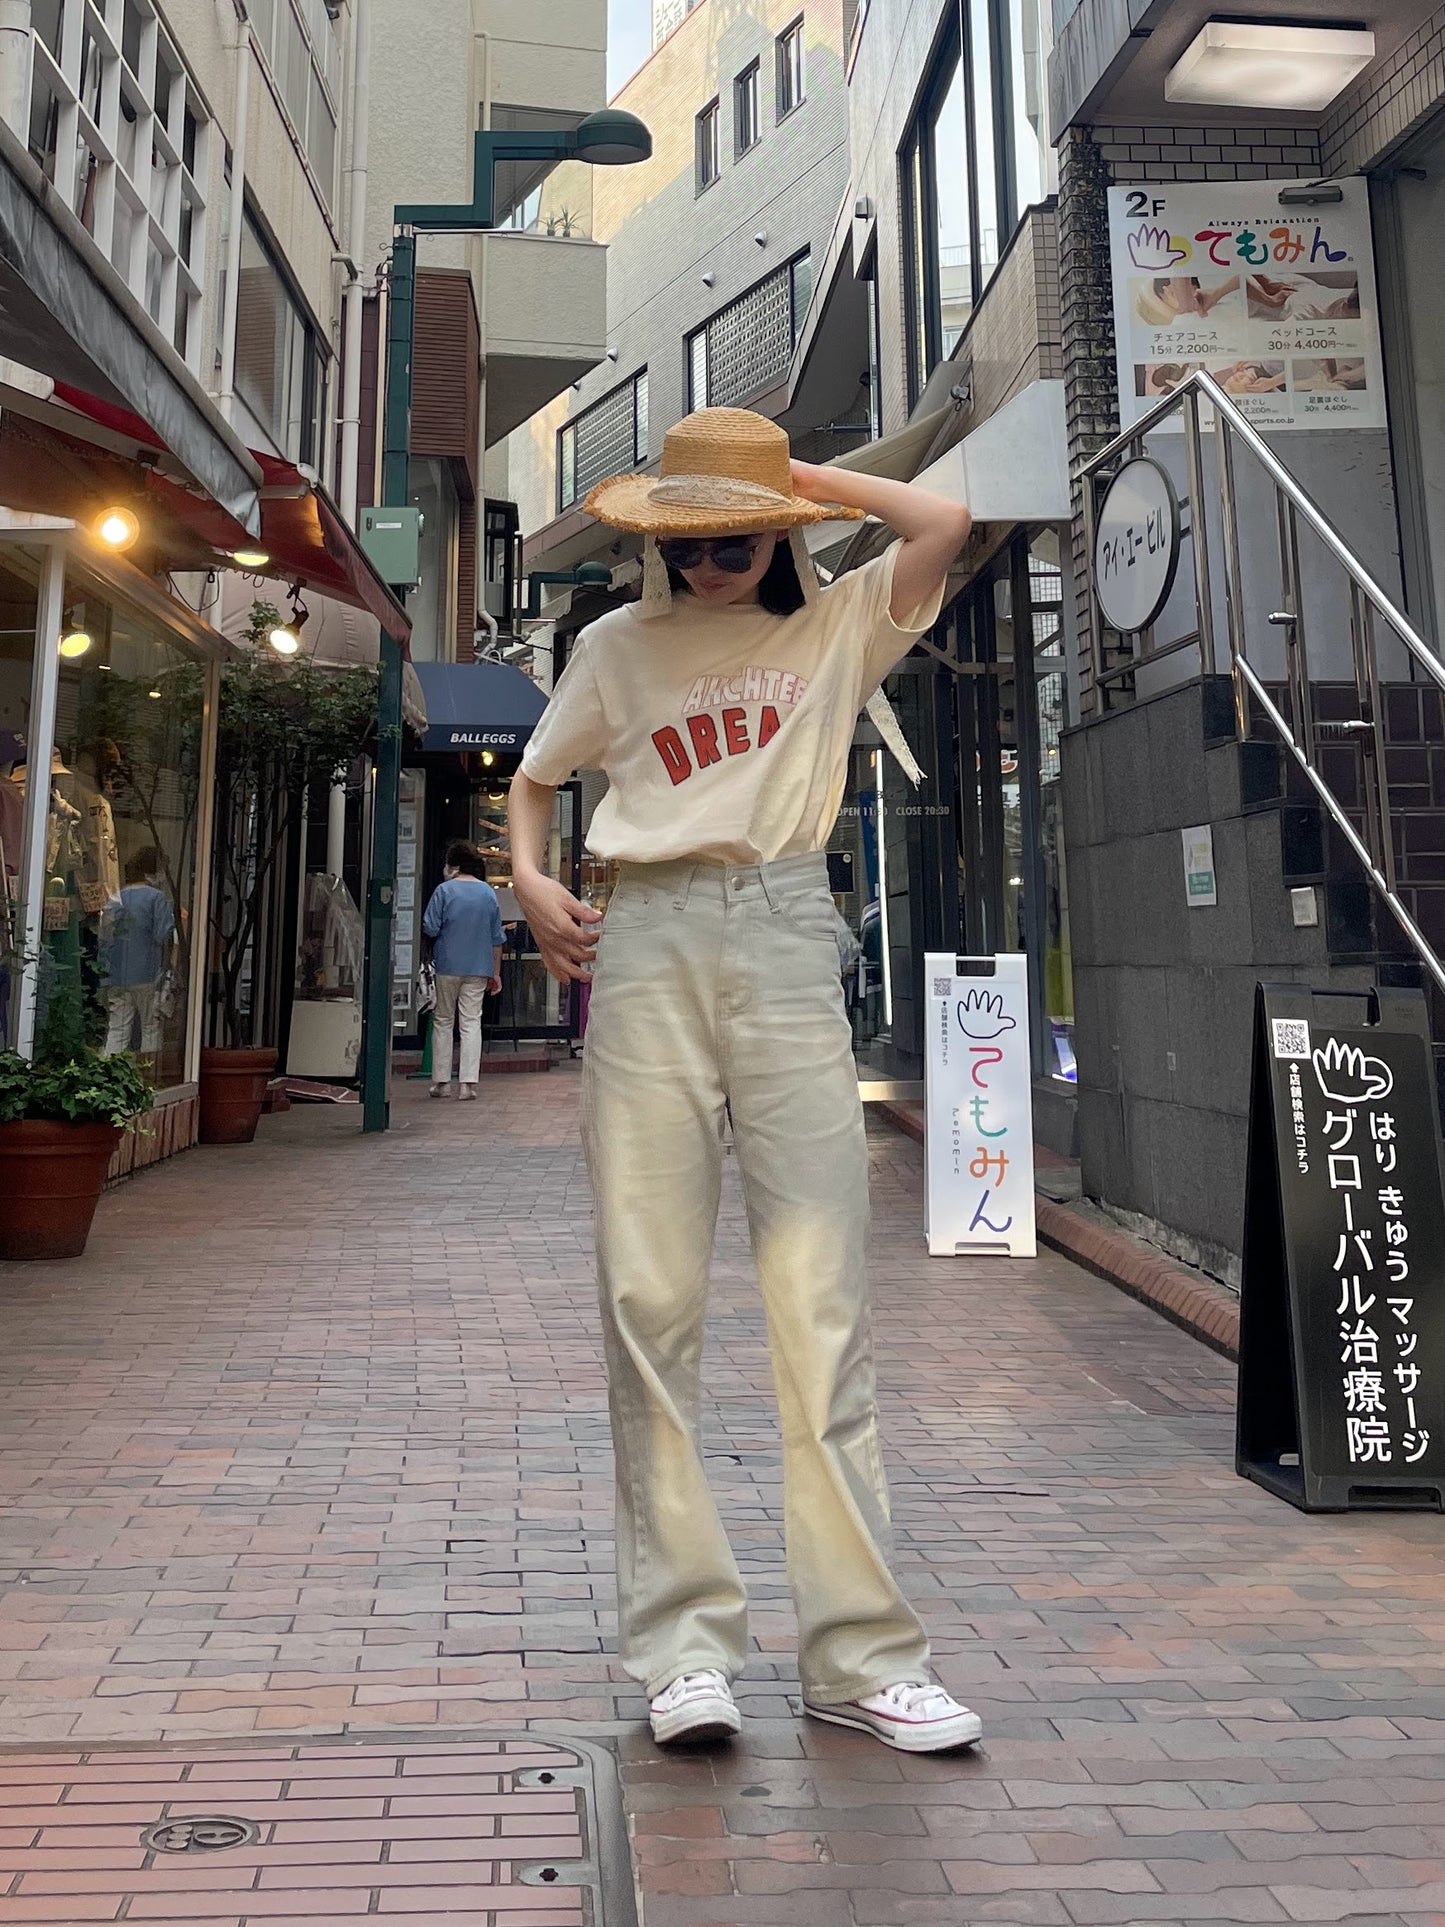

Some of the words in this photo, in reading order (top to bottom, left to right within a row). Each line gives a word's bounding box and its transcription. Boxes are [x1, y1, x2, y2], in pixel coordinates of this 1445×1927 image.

[1125, 191, 1166, 218] 2F
[1208, 220, 1248, 228] Always
[1255, 216, 1320, 226] Relaxation
[1153, 331, 1219, 342] チェアコース
[1268, 340, 1291, 350] 30分
[1271, 326, 1337, 338] ベッドコース
[450, 732, 517, 744] BALLEGGS
[895, 806, 922, 816] CLOSE
[925, 806, 950, 816] 20:30
[1289, 1073, 1310, 1175] 店舗検索はコチラ
[968, 1047, 1014, 1233] てもみん
[1369, 1111, 1397, 1173] はり
[1377, 1185, 1410, 1282] きゅう
[1322, 1108, 1393, 1463] グローバル治療院
[1386, 1297, 1430, 1463] マッサージ
